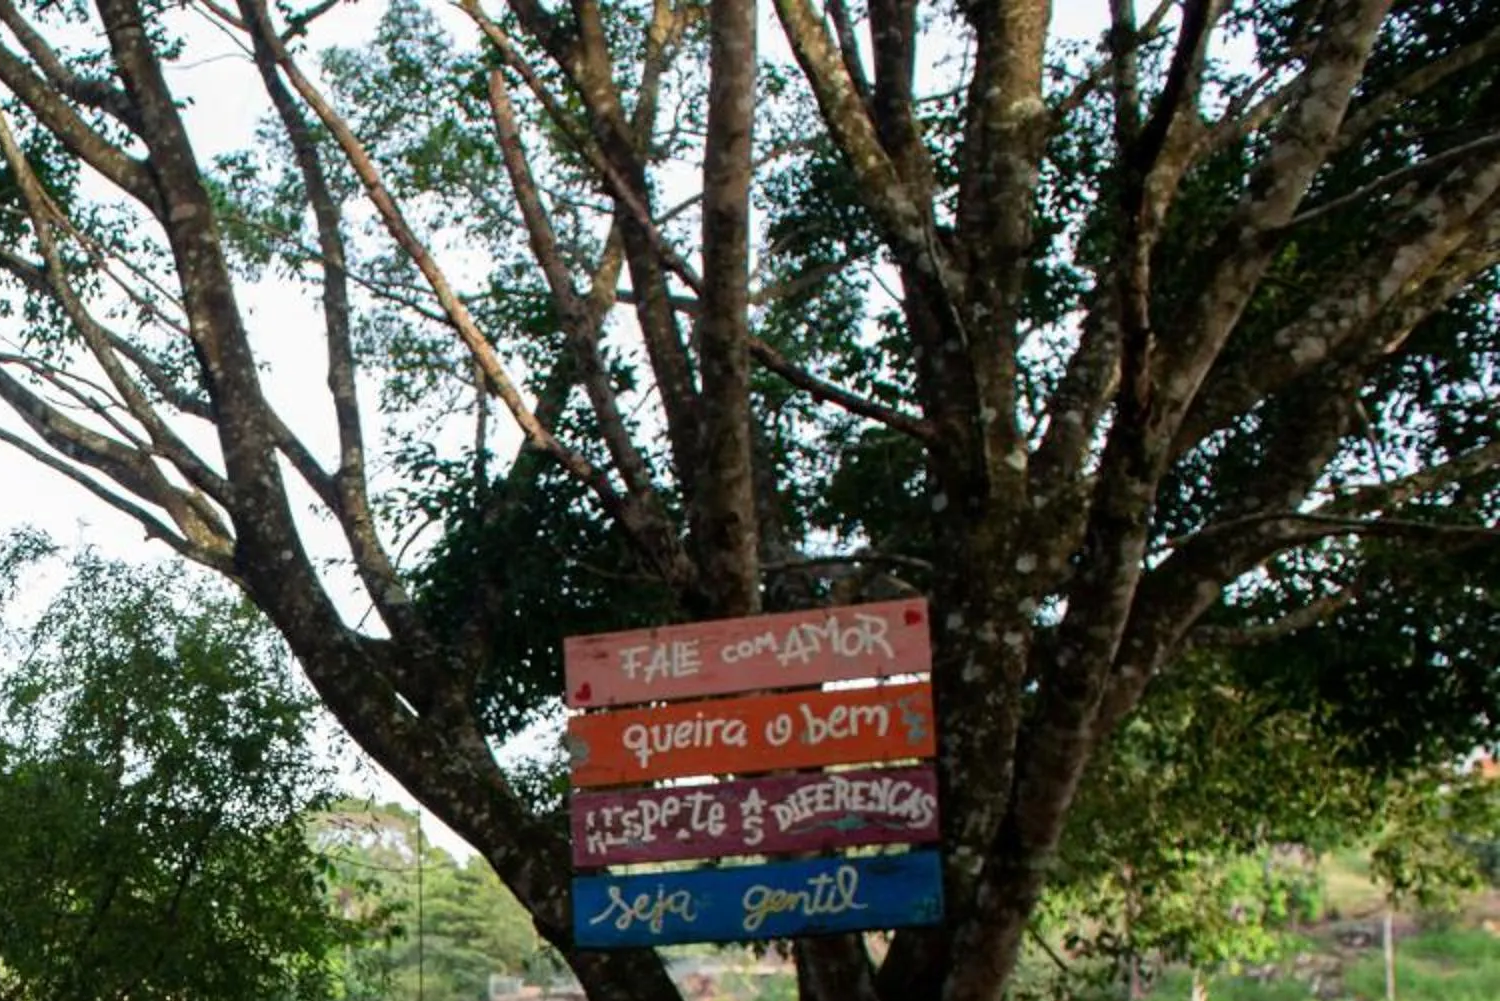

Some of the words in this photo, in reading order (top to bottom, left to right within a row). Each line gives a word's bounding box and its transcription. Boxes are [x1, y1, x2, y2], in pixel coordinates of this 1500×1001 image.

[619, 639, 703, 683] FALE
[776, 613, 895, 667] AMOR
[622, 709, 747, 769] queira
[799, 702, 889, 745] bem
[589, 886, 698, 934] seja
[742, 865, 868, 931] gentil
